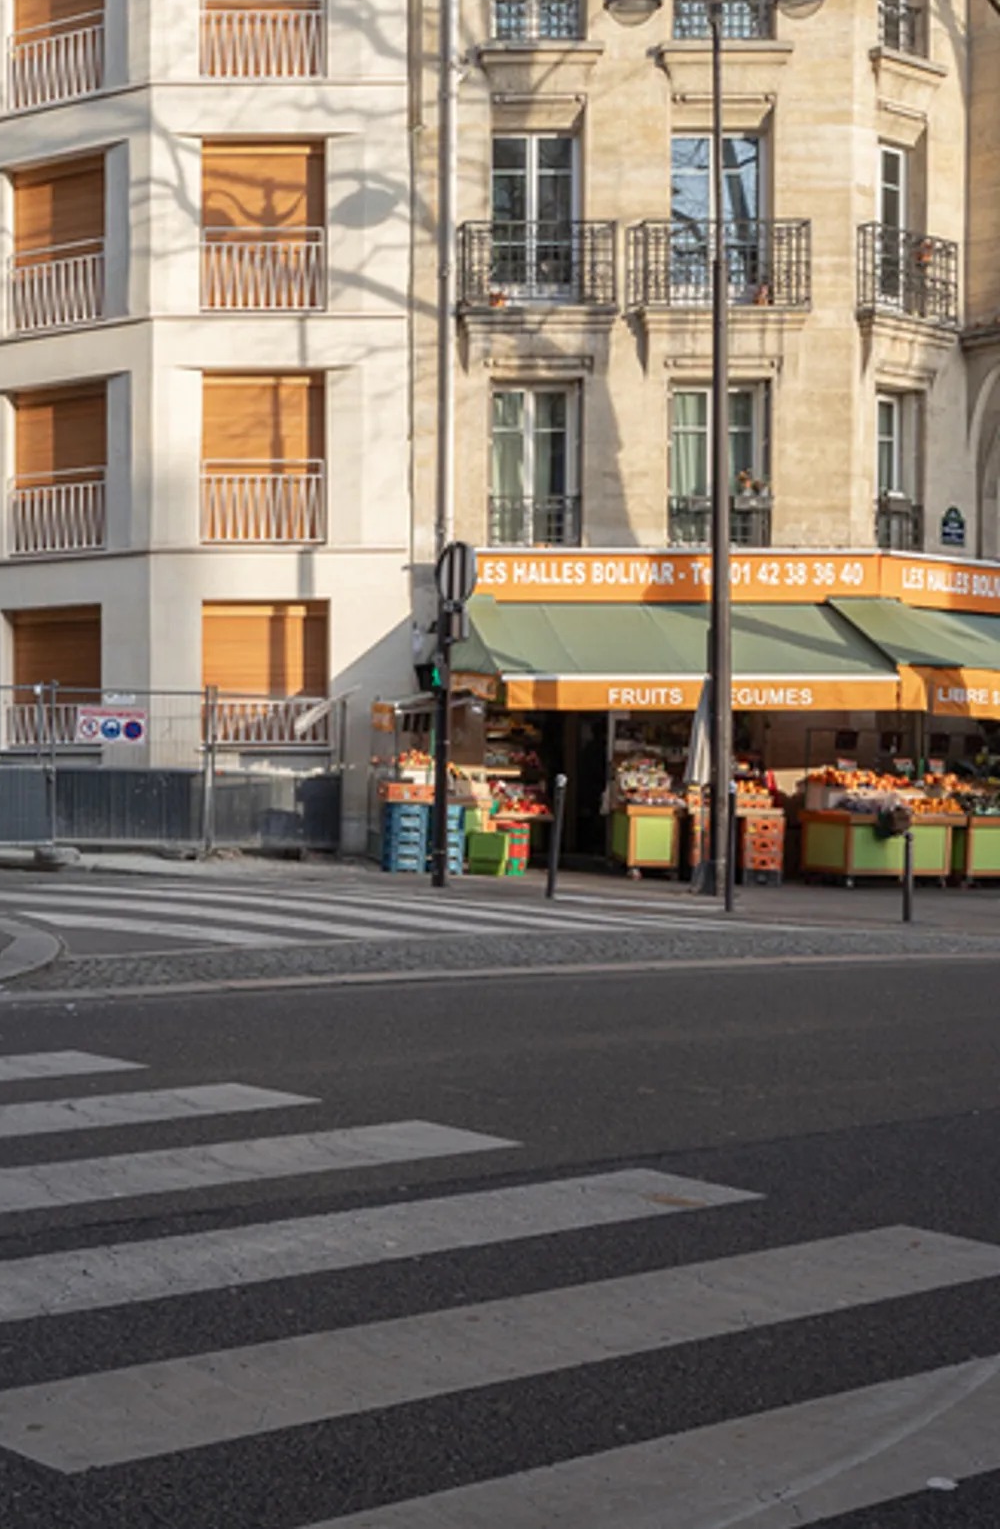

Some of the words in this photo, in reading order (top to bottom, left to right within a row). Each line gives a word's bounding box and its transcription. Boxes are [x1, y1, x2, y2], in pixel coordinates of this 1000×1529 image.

[513, 561, 586, 584] HALLES
[592, 561, 674, 585] BOLIVAR
[728, 562, 751, 585] 01
[757, 562, 780, 585] 42
[784, 562, 807, 585] 38
[812, 562, 836, 585] 36
[840, 562, 864, 585] 40
[902, 567, 924, 589] LES
[927, 569, 968, 595] HALLES
[608, 687, 684, 705] FRUITS
[937, 686, 989, 705] LIBRE
